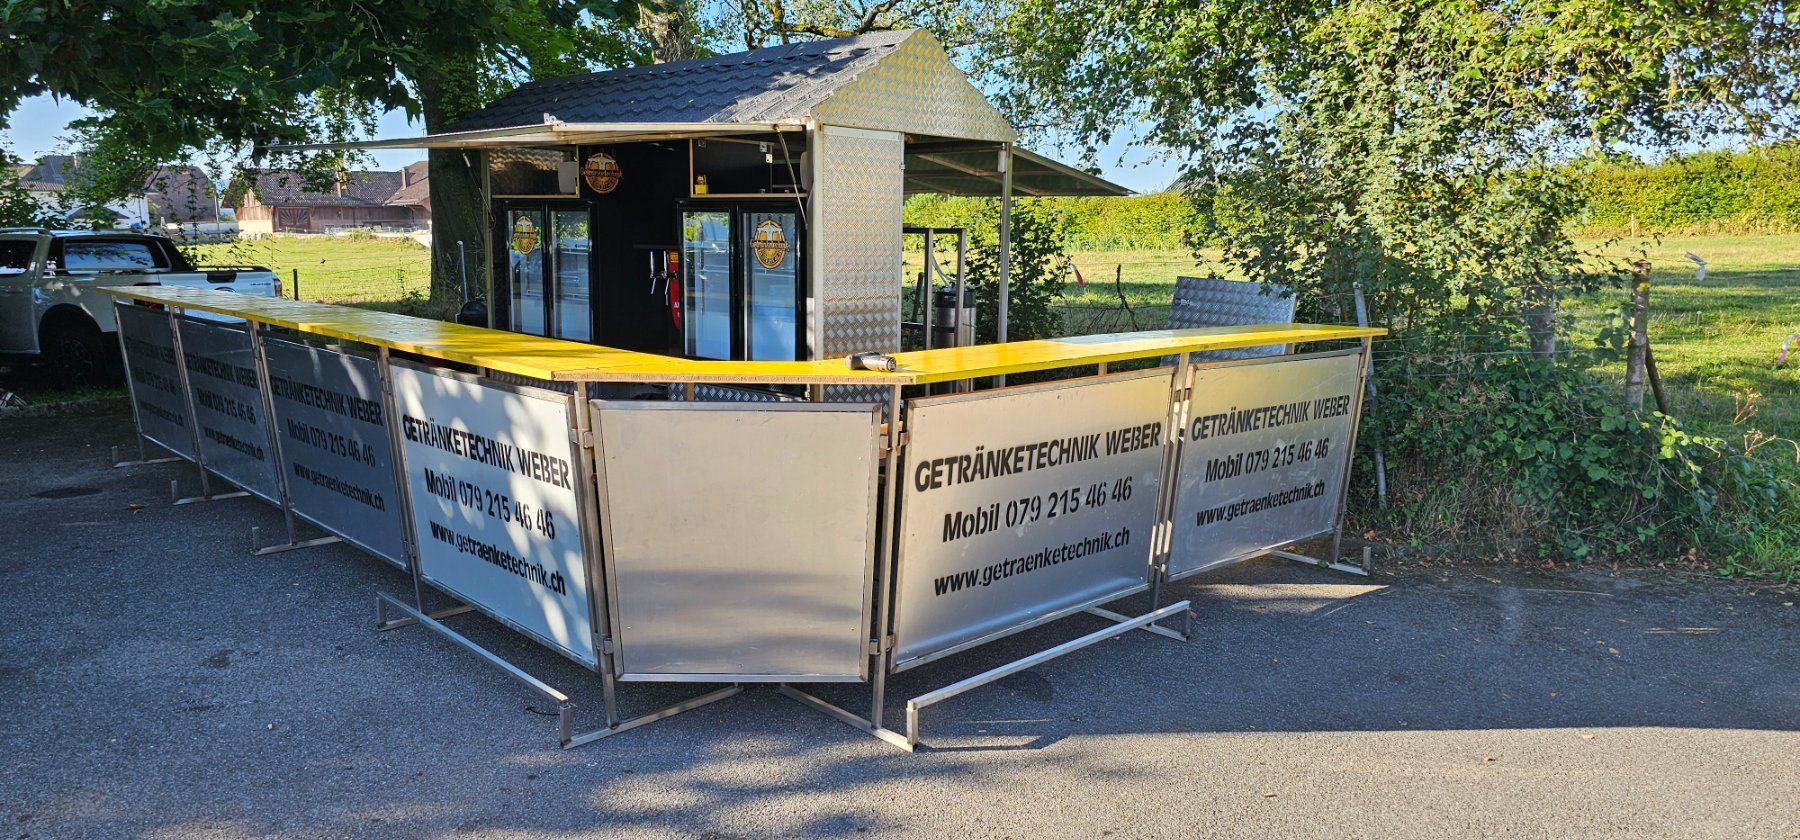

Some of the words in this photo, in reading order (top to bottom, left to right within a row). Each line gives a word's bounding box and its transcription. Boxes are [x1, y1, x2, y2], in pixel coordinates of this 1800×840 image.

[270, 374, 346, 416] GETRÄNKETECHNIK
[347, 395, 384, 426] WEBER
[1191, 400, 1312, 442] GETRÄNKETECHNIK
[1313, 394, 1350, 420] WEBER
[287, 417, 310, 445] Mobil
[310, 427, 328, 450] 079
[328, 431, 346, 458] 215
[348, 438, 360, 463] 46
[362, 443, 376, 468] 46
[402, 413, 515, 472] GETRÄNKETECHNIK
[516, 447, 571, 490] WEBER
[914, 433, 1101, 492] GETRÄNKETECHNIK
[1105, 421, 1162, 456] WEBER
[1204, 453, 1243, 483] Mobil
[1245, 449, 1270, 475] 079
[1272, 444, 1295, 469] 215
[1297, 440, 1312, 462] 46
[1314, 437, 1330, 459] 46
[293, 462, 385, 512] www.getraenketechnik.ch
[424, 467, 457, 503] Mobil
[459, 480, 483, 513] 079
[485, 489, 511, 523] 215
[515, 501, 532, 531] 46
[536, 508, 556, 540] 46
[942, 502, 1000, 543] Mobil
[1005, 495, 1041, 529] 079
[1047, 487, 1081, 519] 215
[1085, 483, 1106, 509] 46
[1111, 475, 1133, 501] 46
[1196, 479, 1325, 527] www.getraenketechnik.ch
[430, 520, 566, 596] www.getraenketechnik.ch
[934, 526, 1130, 596] www.getraenketechnik.ch
